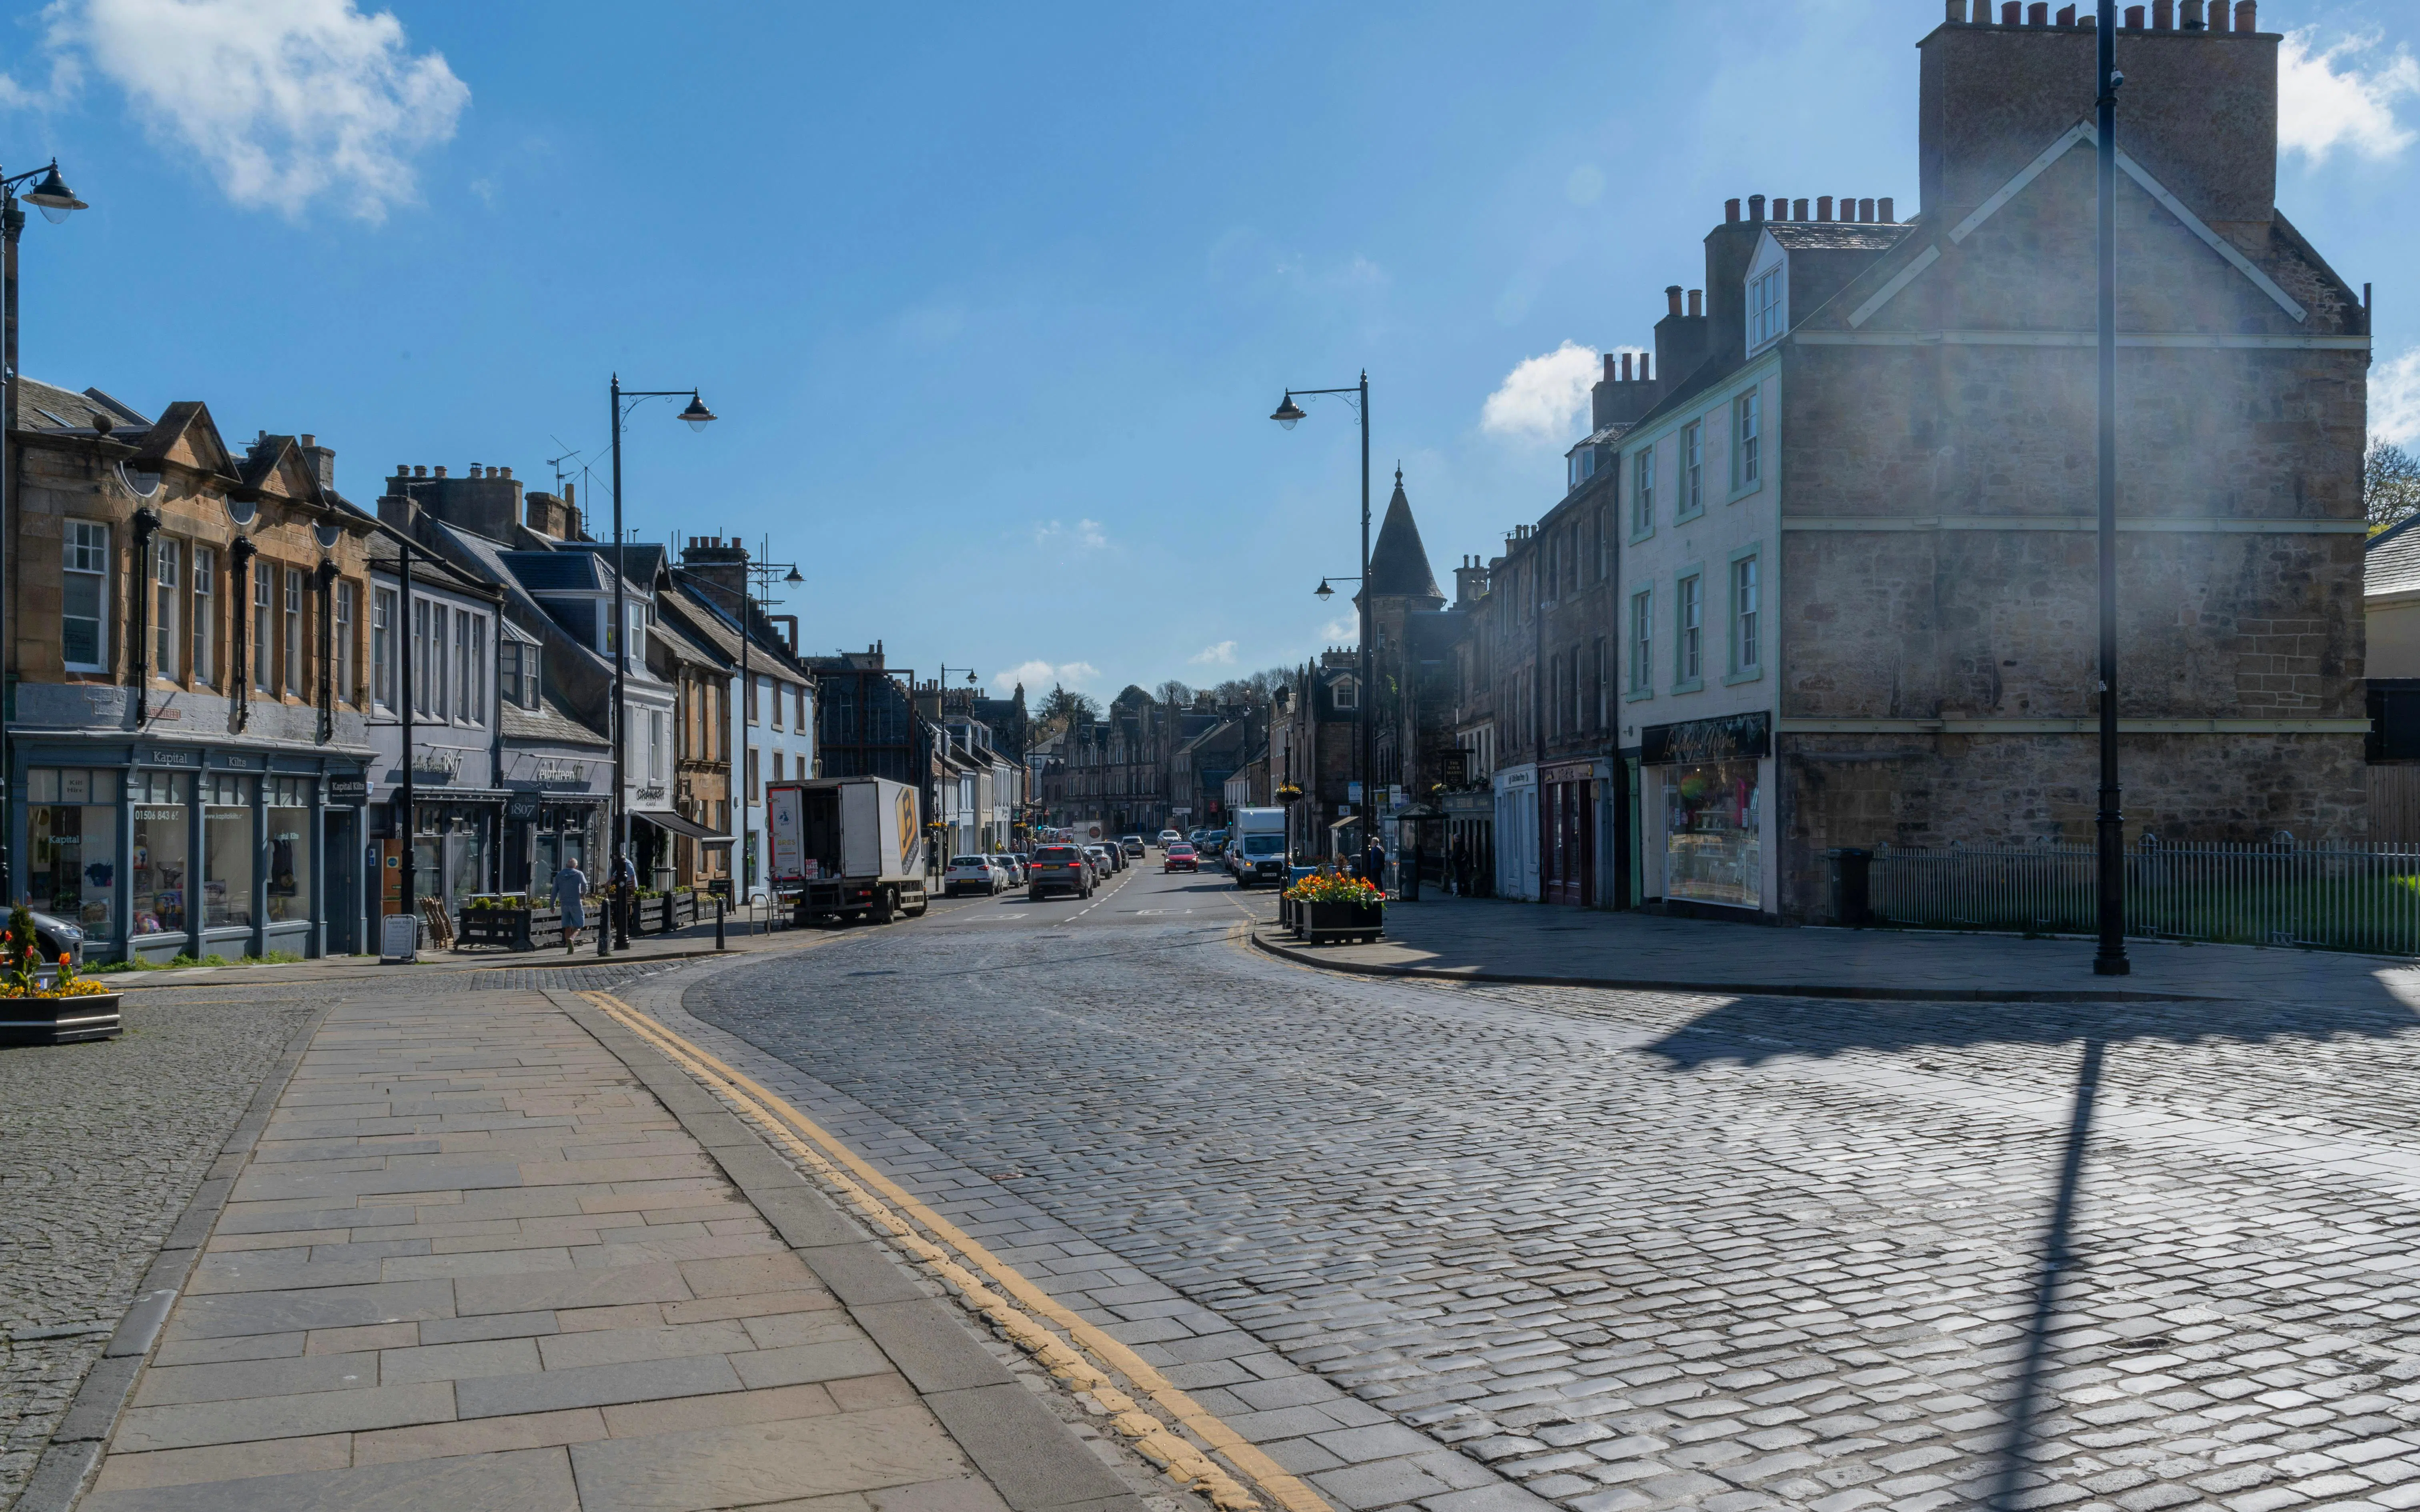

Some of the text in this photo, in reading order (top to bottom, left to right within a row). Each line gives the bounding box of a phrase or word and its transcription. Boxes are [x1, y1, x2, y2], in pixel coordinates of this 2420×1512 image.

[154, 751, 246, 767] Kapital Kilts
[332, 782, 352, 792] Kapital
[353, 782, 365, 790] Kilts
[135, 810, 156, 820] 01506
[158, 810, 170, 820] 843
[510, 802, 535, 818] 1807
[48, 835, 80, 845] Kapital
